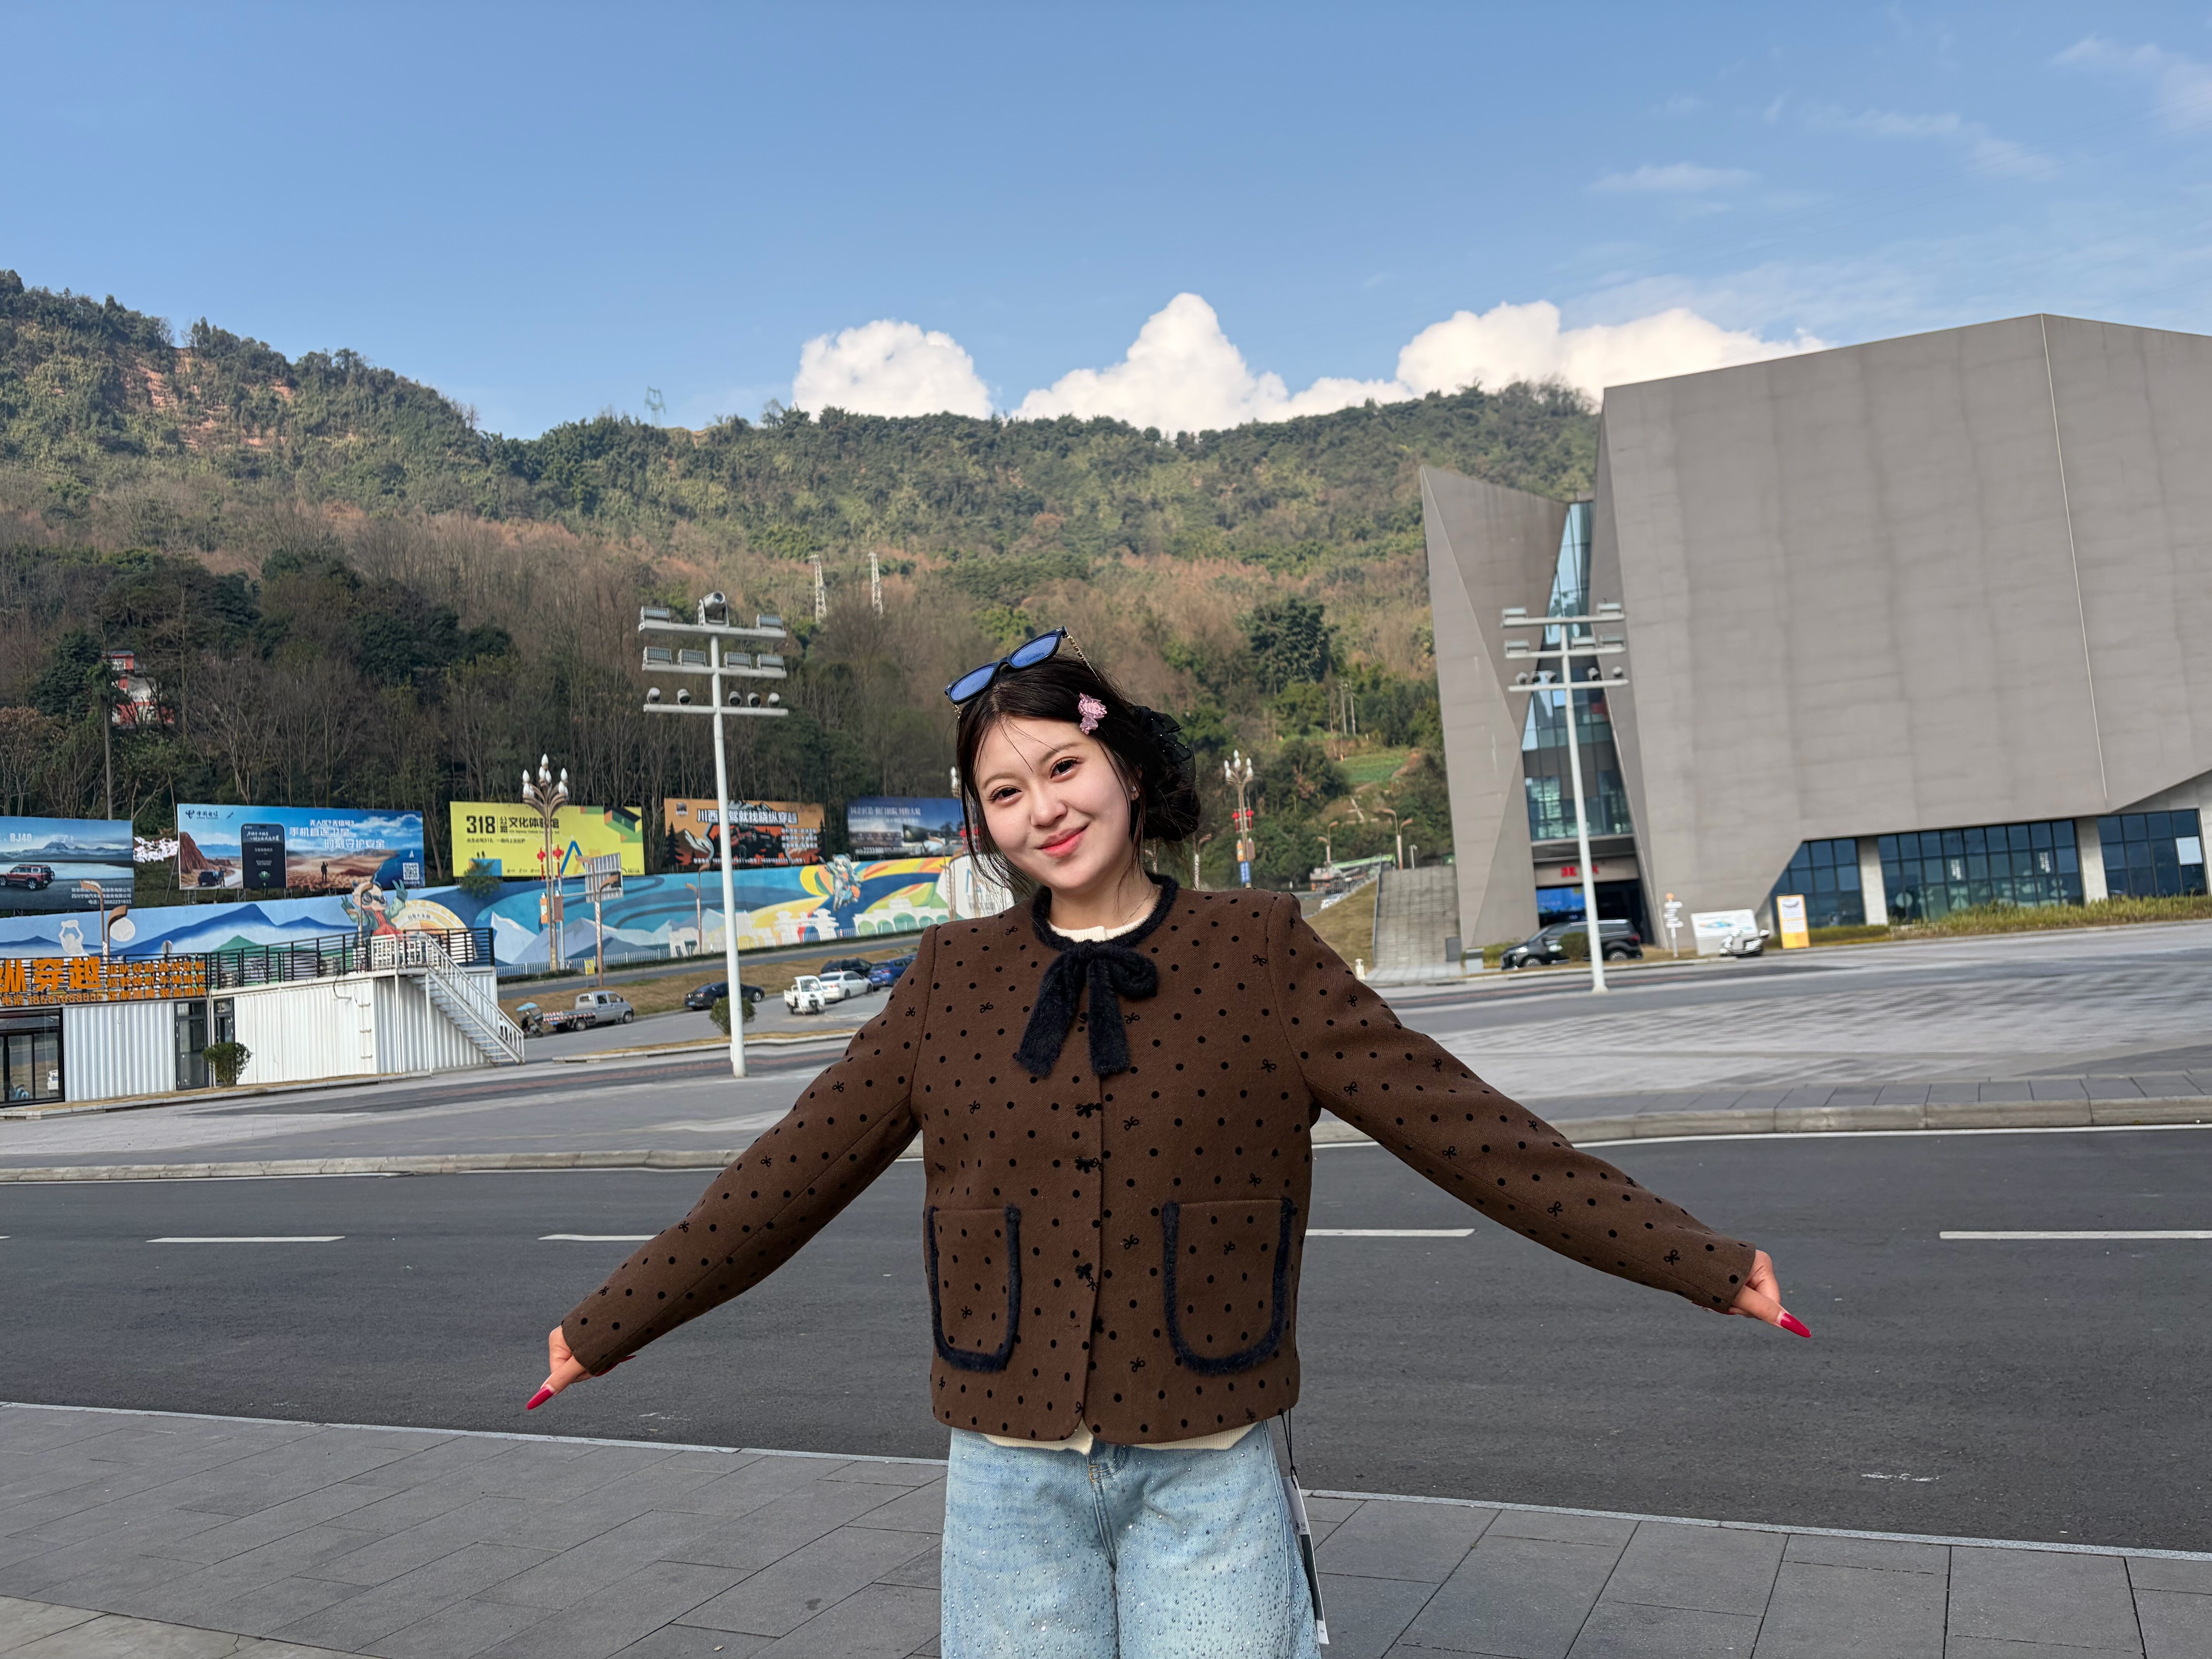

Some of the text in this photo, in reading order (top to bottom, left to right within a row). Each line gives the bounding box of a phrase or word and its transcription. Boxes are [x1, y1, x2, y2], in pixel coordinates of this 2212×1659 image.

[466, 815, 496, 834] 318
[697, 809, 798, 824] 川西驾就找晓纵穿越
